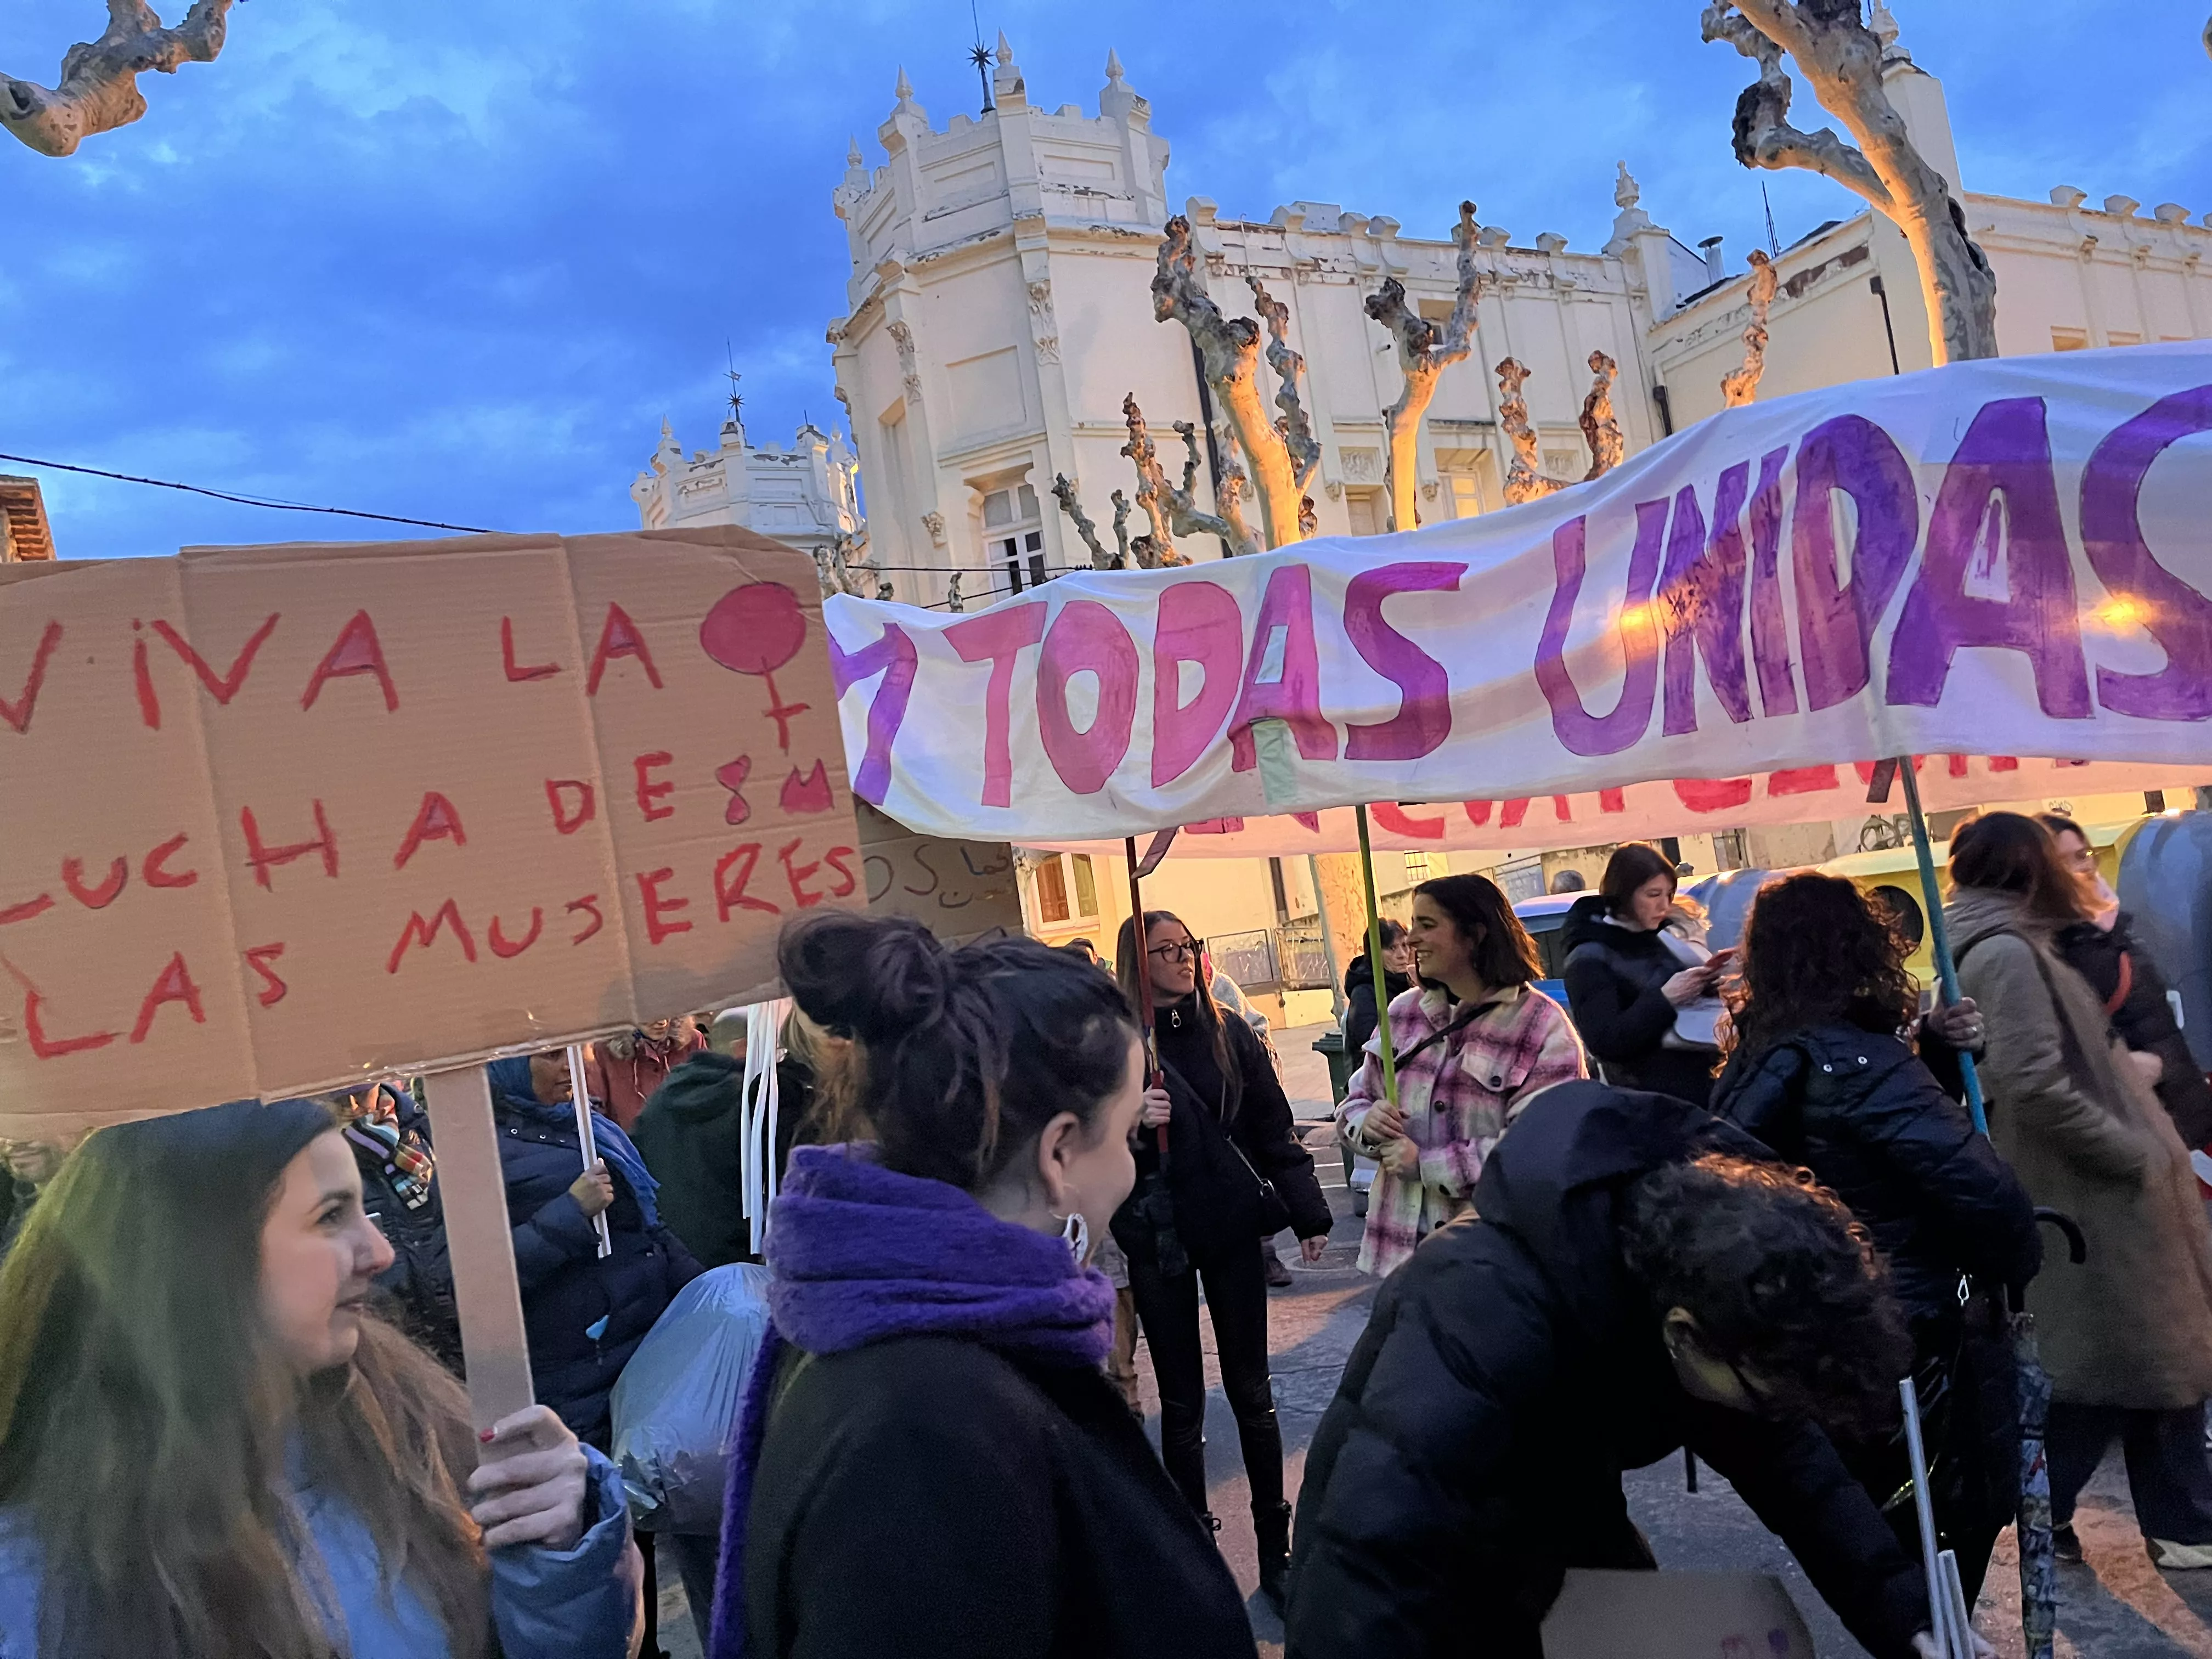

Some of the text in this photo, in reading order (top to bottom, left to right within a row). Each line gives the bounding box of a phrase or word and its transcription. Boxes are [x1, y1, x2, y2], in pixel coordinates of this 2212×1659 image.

[496, 601, 664, 697] LA
[943, 561, 1469, 808] TODAS
[1534, 384, 2212, 756] UNIDAS
[544, 751, 675, 834] DE
[24, 942, 288, 1060] LAS
